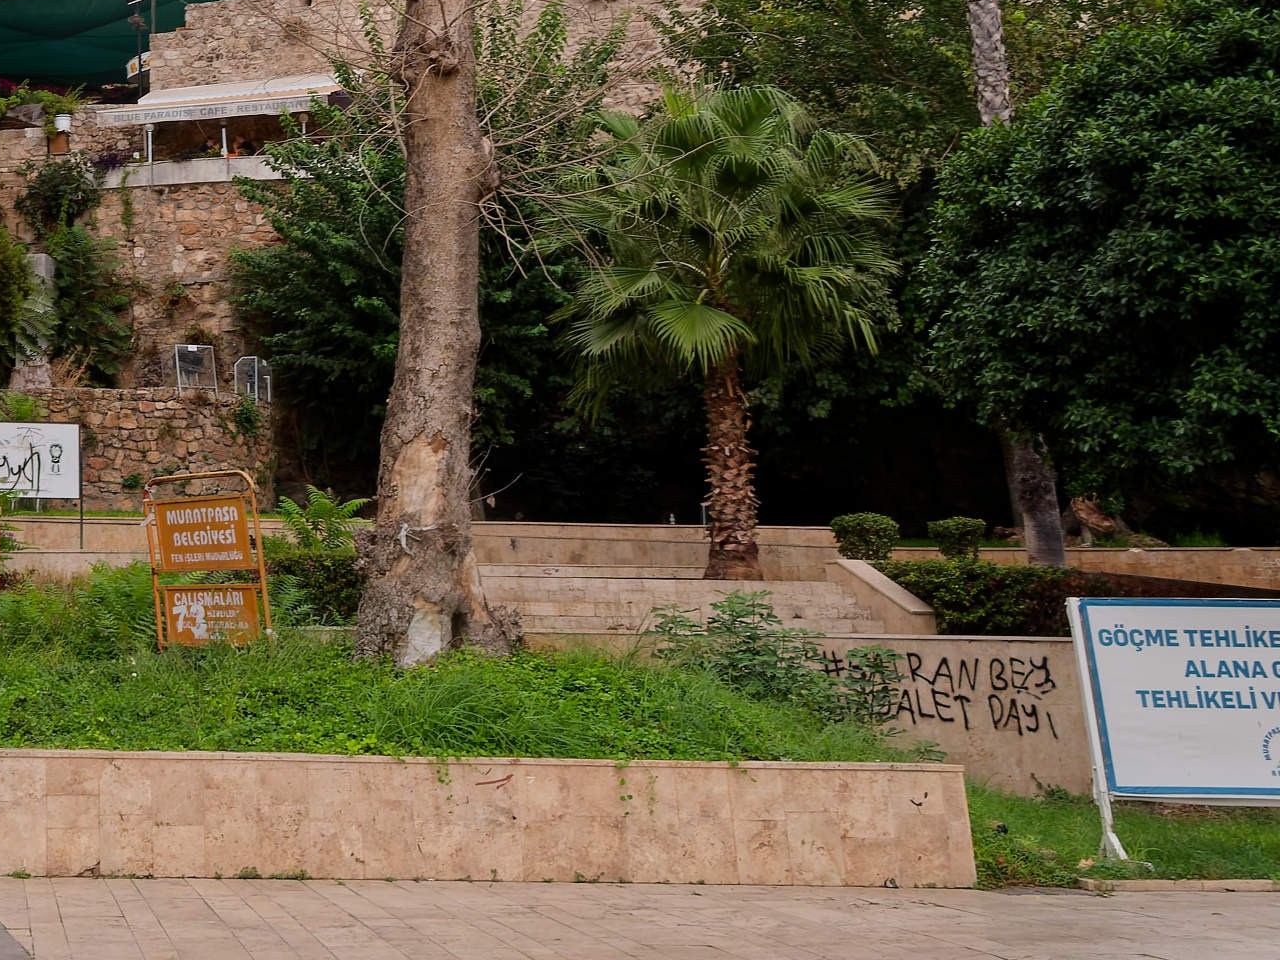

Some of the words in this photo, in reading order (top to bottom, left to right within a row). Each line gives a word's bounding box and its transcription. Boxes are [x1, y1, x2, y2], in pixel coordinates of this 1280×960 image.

[113, 113, 141, 123] BLUE
[200, 106, 228, 117] CAFE
[166, 506, 238, 525] MURATPAŞA
[173, 524, 237, 547] BELEDİYESİ
[1097, 623, 1180, 652] GÖÇME
[1185, 660, 1268, 679] ALANA
[1135, 685, 1258, 710] TEHLİKELİ
[1260, 691, 1280, 710] V
